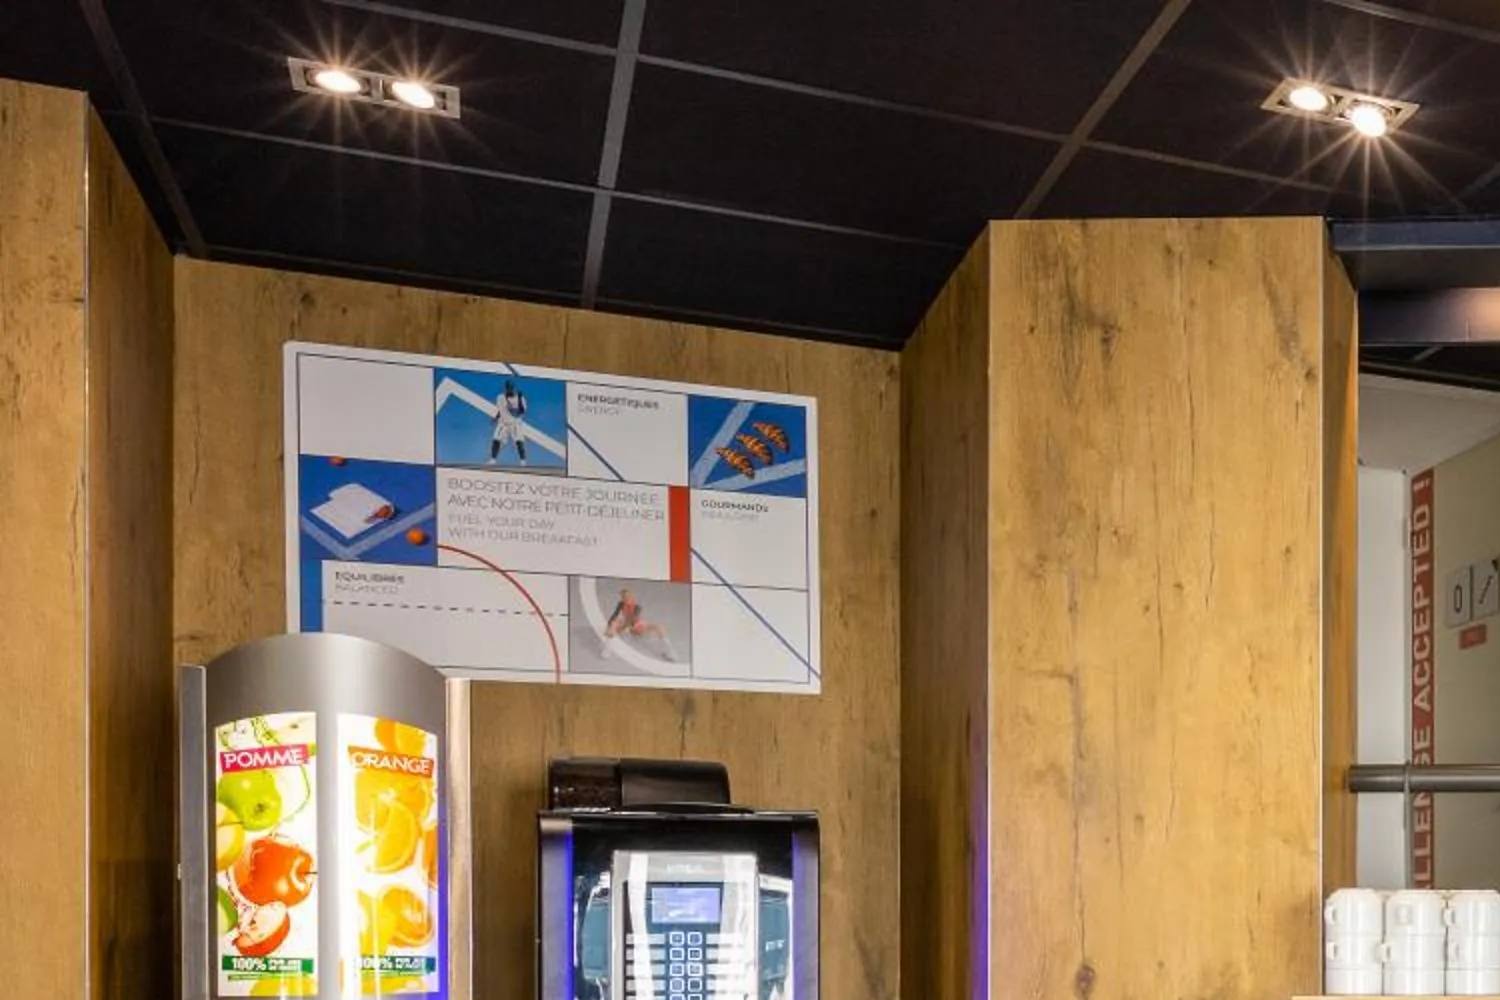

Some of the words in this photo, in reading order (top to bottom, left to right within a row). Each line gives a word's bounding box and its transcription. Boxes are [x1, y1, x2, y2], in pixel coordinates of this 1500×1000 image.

[448, 478, 525, 495] BOOSTEZ
[527, 484, 583, 500] VOTRE
[448, 493, 491, 509] AVEC
[492, 498, 542, 513] NOTRE
[1413, 503, 1431, 712] ACCEPTED
[223, 748, 304, 769] POMME
[350, 752, 431, 774] ORANGE
